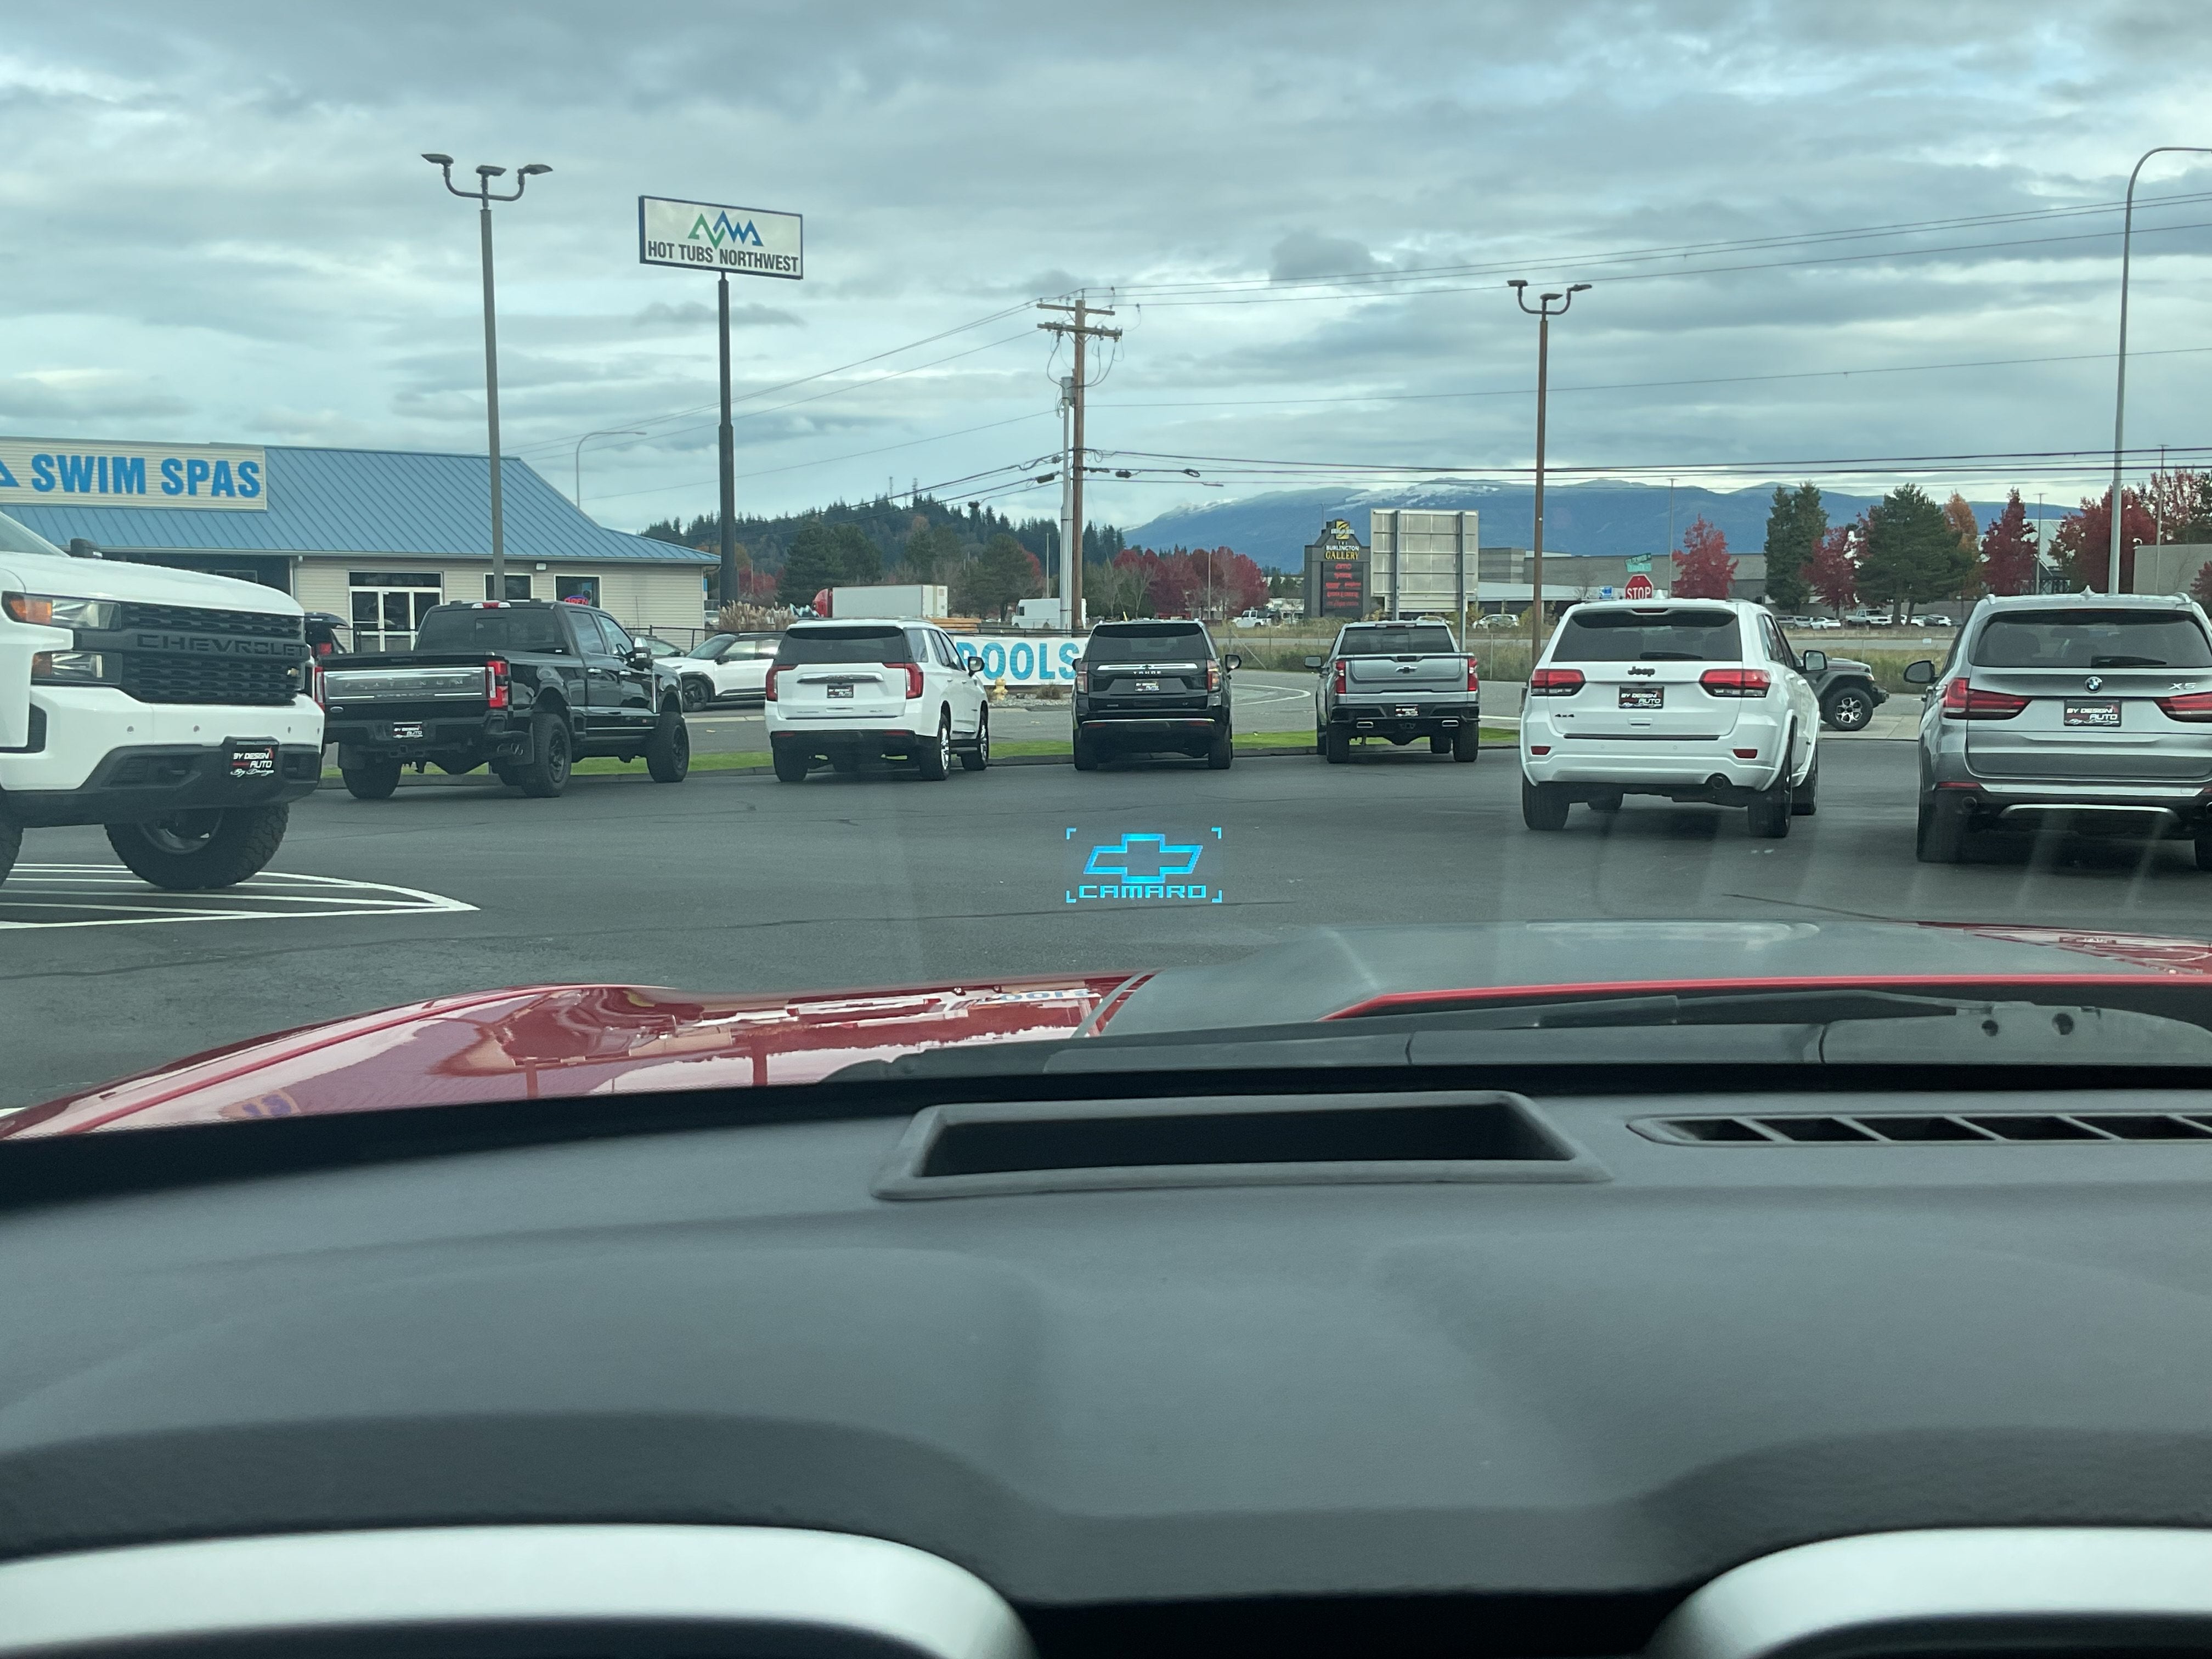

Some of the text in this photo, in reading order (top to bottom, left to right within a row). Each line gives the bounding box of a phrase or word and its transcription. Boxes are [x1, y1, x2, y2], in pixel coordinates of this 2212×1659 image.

[648, 240, 799, 272] HOT TUBS NORTHWEST
[31, 454, 261, 498] SWIM SPAS
[1325, 551, 1359, 560] GALLERY
[1627, 586, 1651, 599] STOP
[137, 634, 305, 657] CHEVROLET
[956, 642, 1080, 680] POOLS
[1628, 666, 1655, 677] Jeep
[2168, 682, 2197, 690] X5
[1079, 885, 1206, 898] CAMARO
